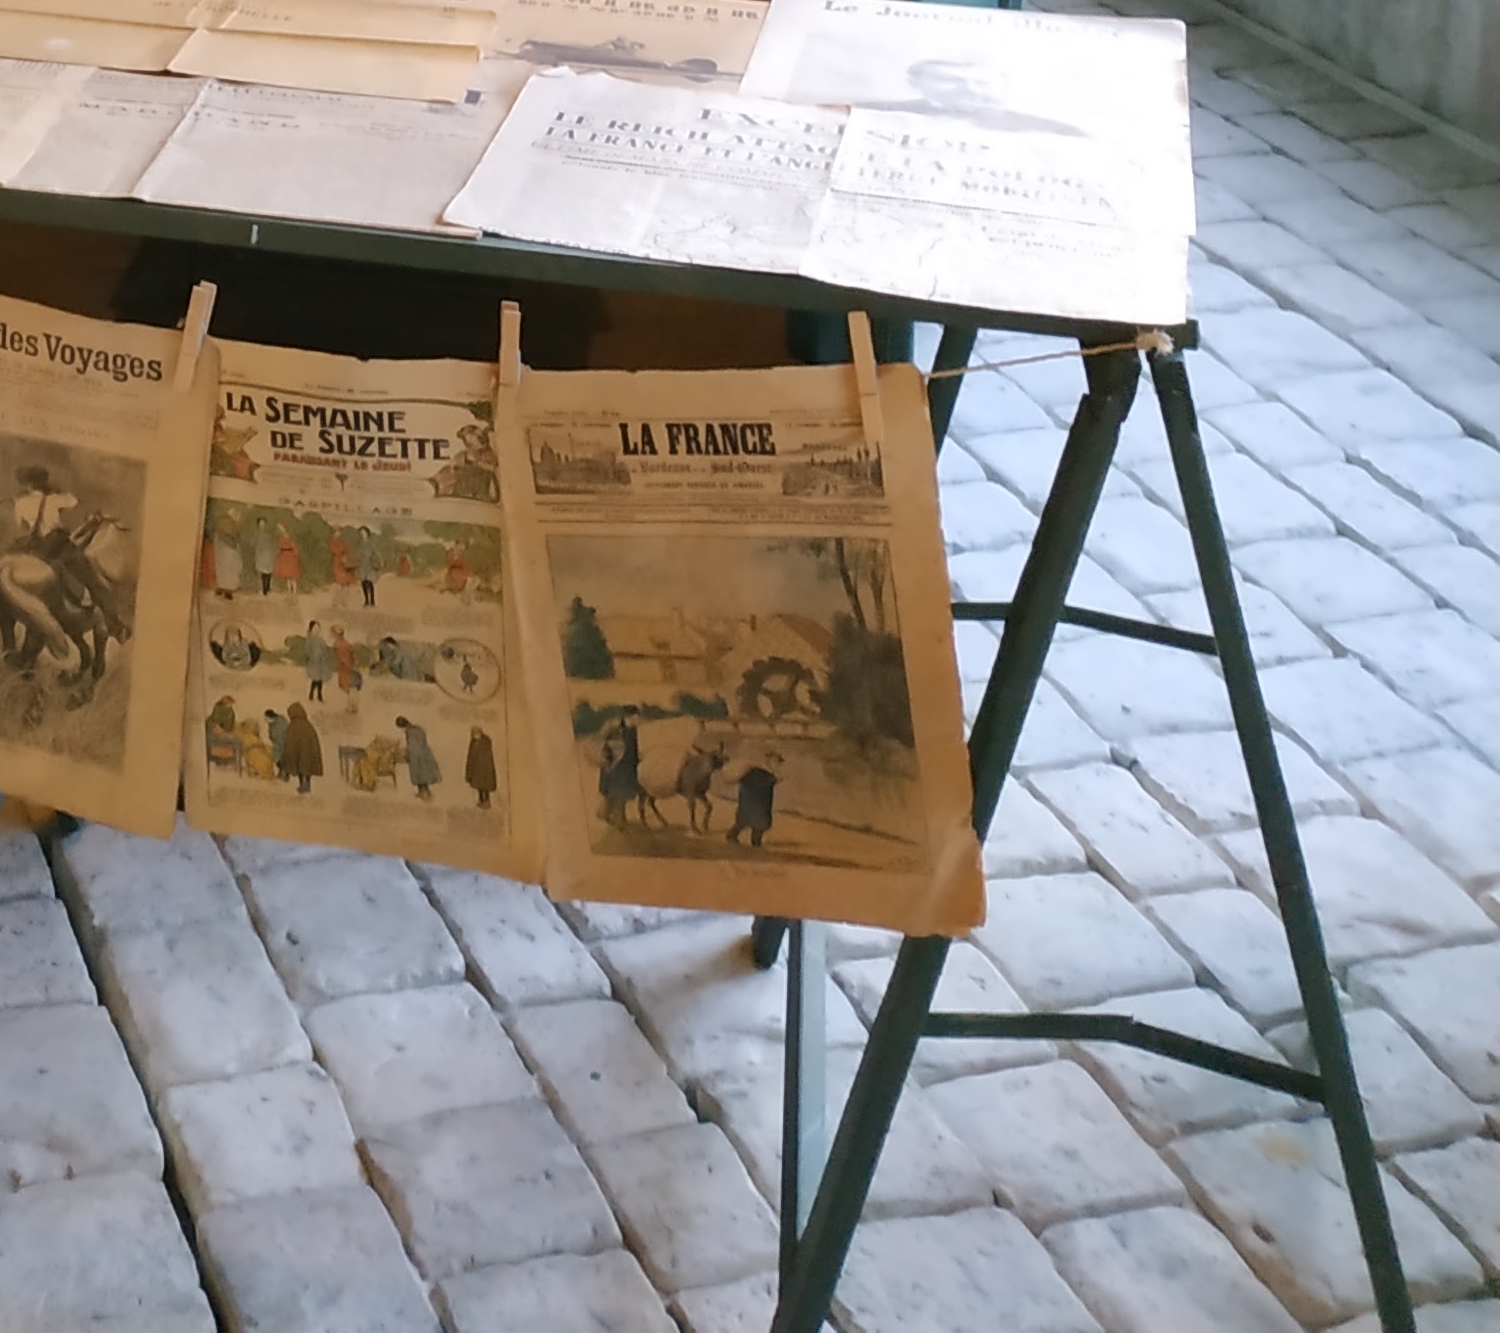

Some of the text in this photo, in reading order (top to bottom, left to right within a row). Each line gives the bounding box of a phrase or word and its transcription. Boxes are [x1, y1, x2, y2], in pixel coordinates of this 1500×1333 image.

[43, 332, 164, 384] Voyages
[226, 391, 407, 434] LA SEMAINE
[270, 429, 452, 462] DE SUZETTE
[618, 422, 659, 456] LA
[665, 421, 777, 457] FRANCE
